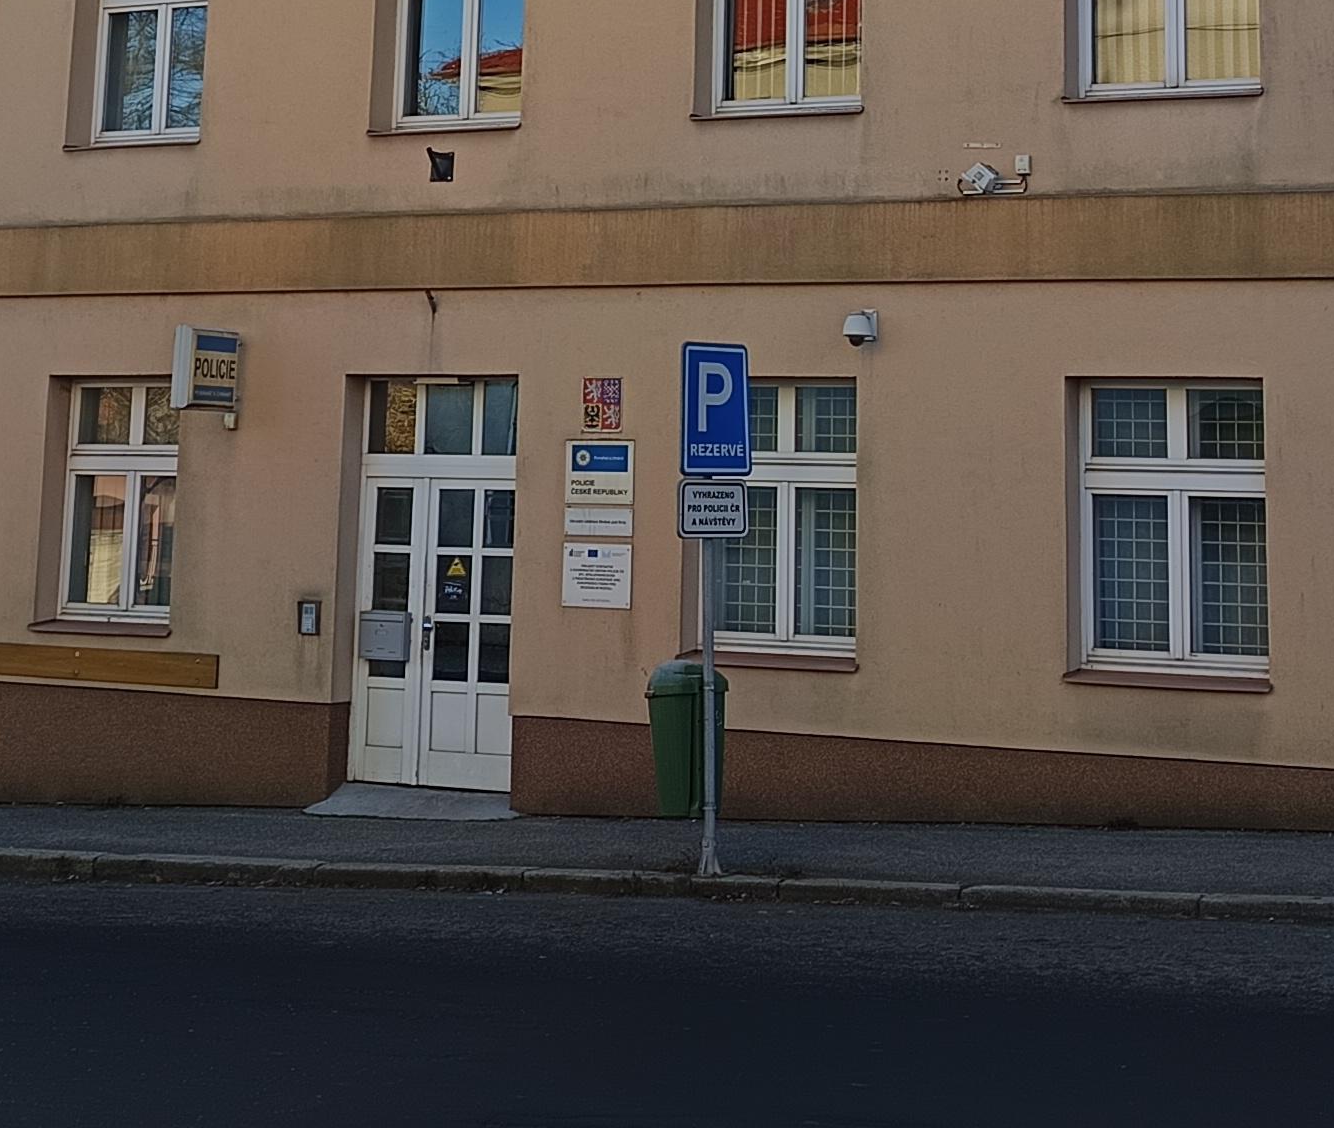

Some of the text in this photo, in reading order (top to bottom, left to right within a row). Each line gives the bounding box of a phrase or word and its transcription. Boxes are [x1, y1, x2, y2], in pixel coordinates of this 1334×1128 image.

[194, 357, 237, 380] POLICIE
[697, 361, 733, 433] P
[690, 440, 744, 457] REZERVÉ
[571, 479, 595, 487] POLICIE
[570, 487, 628, 496] ČESKÉ REPUBLIKY
[692, 490, 735, 500] VYHRAZENO
[687, 502, 740, 513] PRO POLICII ČR
[691, 515, 736, 527] A NÁVŠTĚVY
